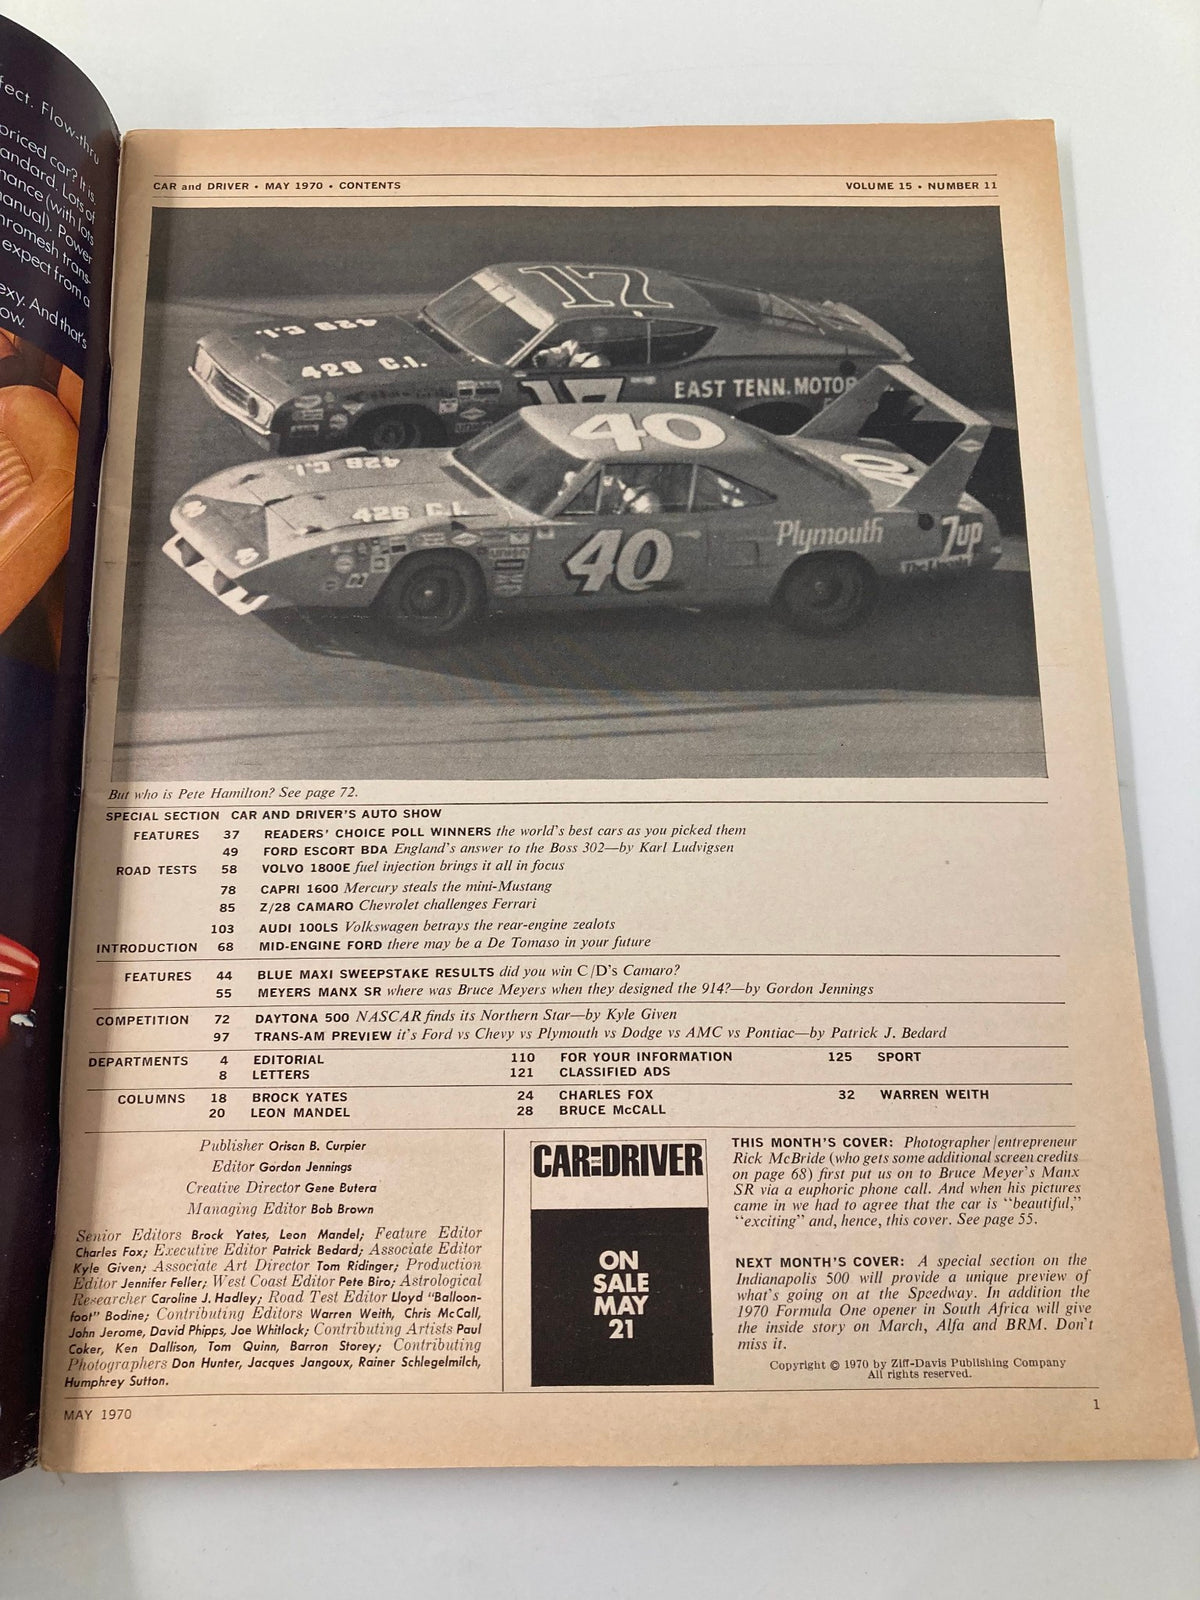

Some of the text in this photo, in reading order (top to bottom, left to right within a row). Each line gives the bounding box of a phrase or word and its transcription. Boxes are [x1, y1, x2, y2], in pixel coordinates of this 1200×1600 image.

[41, 101, 99, 165] Flow-thru
[50, 156, 78, 183] car?
[153, 181, 401, 191] CAR and DRIVER MAY 1970 CONTENTS
[845, 181, 998, 191] VOLUME 15 NUMBER 11
[62, 182, 84, 213] Lots
[0, 191, 93, 264] anual). Power
[78, 218, 94, 246] lots
[2, 239, 91, 308] expect from a
[518, 265, 674, 309] 17
[29, 298, 58, 326] And
[674, 379, 727, 399] EAST
[732, 378, 792, 398] TENN.
[570, 412, 726, 452] 40
[774, 517, 884, 554] Plymouth
[565, 527, 674, 593] 40
[108, 786, 358, 800] But who is Pete Hamilton? See page 72.
[105, 810, 220, 822] SPECIAL SECTION
[230, 808, 442, 820] CAR AND DRIVER'S AUTO SHOW
[133, 830, 200, 841] FEATURES
[222, 830, 240, 840] 37
[264, 823, 746, 840] READERS' CHOICE POLL WINNERS the world's best cars as you picked them
[116, 864, 198, 876] ROAD TESTS
[220, 864, 238, 875] 58
[261, 858, 566, 875] VOLVO 1800E fuel injection brings it all in focus
[124, 971, 192, 983] FEATURES
[216, 970, 233, 981] 44
[257, 967, 495, 980] BLUE MAXI SWEEPSTAKE RESULTS
[96, 1014, 189, 1026] COMPETITION
[214, 1014, 230, 1025] 72
[255, 1012, 350, 1024] DAYTONA 500
[88, 1055, 189, 1068] DEPARTMENTS
[219, 1055, 229, 1066] 4
[253, 1054, 325, 1066] EDITORIAL
[511, 1052, 536, 1063] 110
[560, 1050, 733, 1063] FOR YOUR INFORMATION
[828, 1051, 853, 1062] 125
[877, 1051, 922, 1063] SPORT
[117, 1093, 186, 1105] COLUMNS
[210, 1092, 228, 1104] 18
[252, 1091, 348, 1103] BROCK YATES
[516, 1090, 534, 1101] 24
[558, 1089, 654, 1101] CHARLES FOX
[838, 1089, 856, 1100] 32
[879, 1088, 990, 1100] WARREN WEITH
[199, 1138, 264, 1152] Publisher
[309, 1140, 320, 1152] B.
[325, 1139, 367, 1154] Curpier
[730, 1136, 894, 1148] THIS MONTH'S COVER:
[211, 1159, 353, 1174] Editor Gordon Jennings
[533, 1144, 591, 1178] CAR
[602, 1143, 704, 1177] DRIVER
[599, 1250, 639, 1271] ON
[735, 1256, 904, 1269] NEXT MONTH'S COVER:
[592, 1272, 650, 1294] SALE
[593, 1295, 649, 1316] MAY
[608, 1319, 634, 1339] 21
[769, 1357, 1066, 1372] Copyright © 1970 by Ziff-Davis Publishing Company
[64, 1374, 169, 1390] Humphrey Sutton.
[1093, 1398, 1100, 1410] 1
[64, 1408, 132, 1420] MAY 1970
